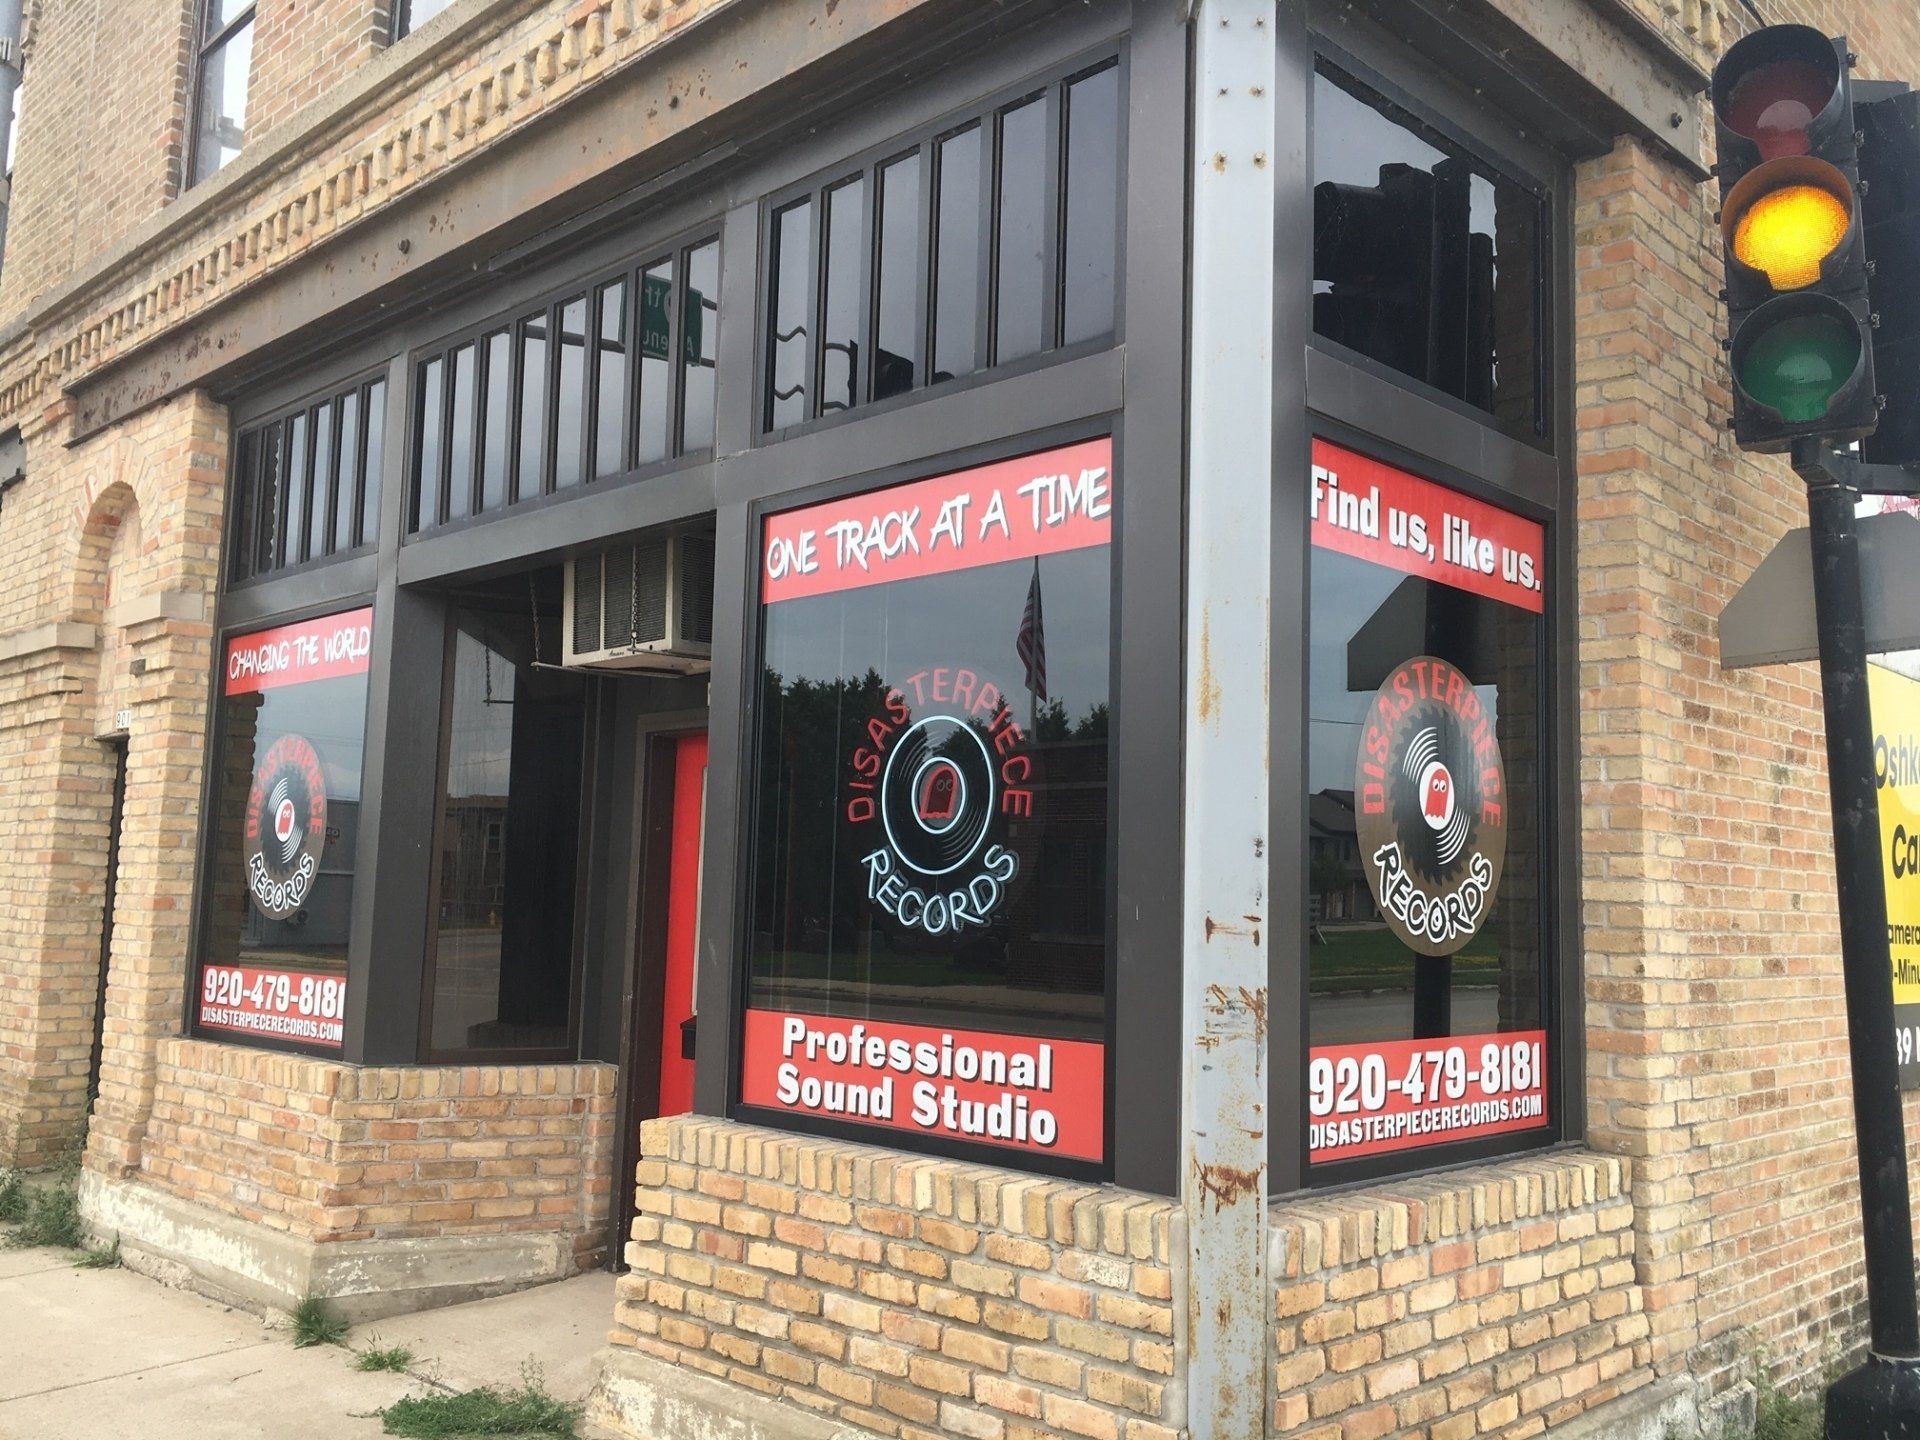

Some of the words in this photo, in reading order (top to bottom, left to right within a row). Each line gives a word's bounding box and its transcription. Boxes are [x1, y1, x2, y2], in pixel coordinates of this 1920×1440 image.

[766, 528, 818, 579] ONE
[825, 505, 921, 571] TRACK
[929, 492, 971, 549] AT
[979, 489, 1010, 540] A
[1017, 466, 1112, 532] TIME
[1310, 464, 1379, 538] Find
[1389, 507, 1435, 562] us,
[1443, 512, 1495, 574] like
[1502, 546, 1541, 590] us.
[229, 640, 290, 680] CHANGING
[293, 635, 320, 668] THE
[324, 626, 371, 664] WORLD
[848, 667, 1034, 823] DISASTERPIECE
[1363, 660, 1502, 828] DISASTERPIECE
[1874, 734, 1920, 789] Oshk
[250, 851, 314, 912] RECORDS
[1892, 824, 1920, 879] Ca
[861, 845, 1018, 933] RECORDS
[1373, 842, 1493, 943] RECORDS
[201, 1006, 343, 1042] DISASTERPIECERECORDS.COM
[204, 968, 346, 1020] 920-479-8181
[782, 1017, 1053, 1090] Professional
[1309, 1041, 1541, 1116] 920-479-8181
[776, 1062, 893, 1119] Sound
[911, 1080, 1057, 1145] Studio
[1309, 1094, 1542, 1149] DISASTERPIECERECORDS.COM
